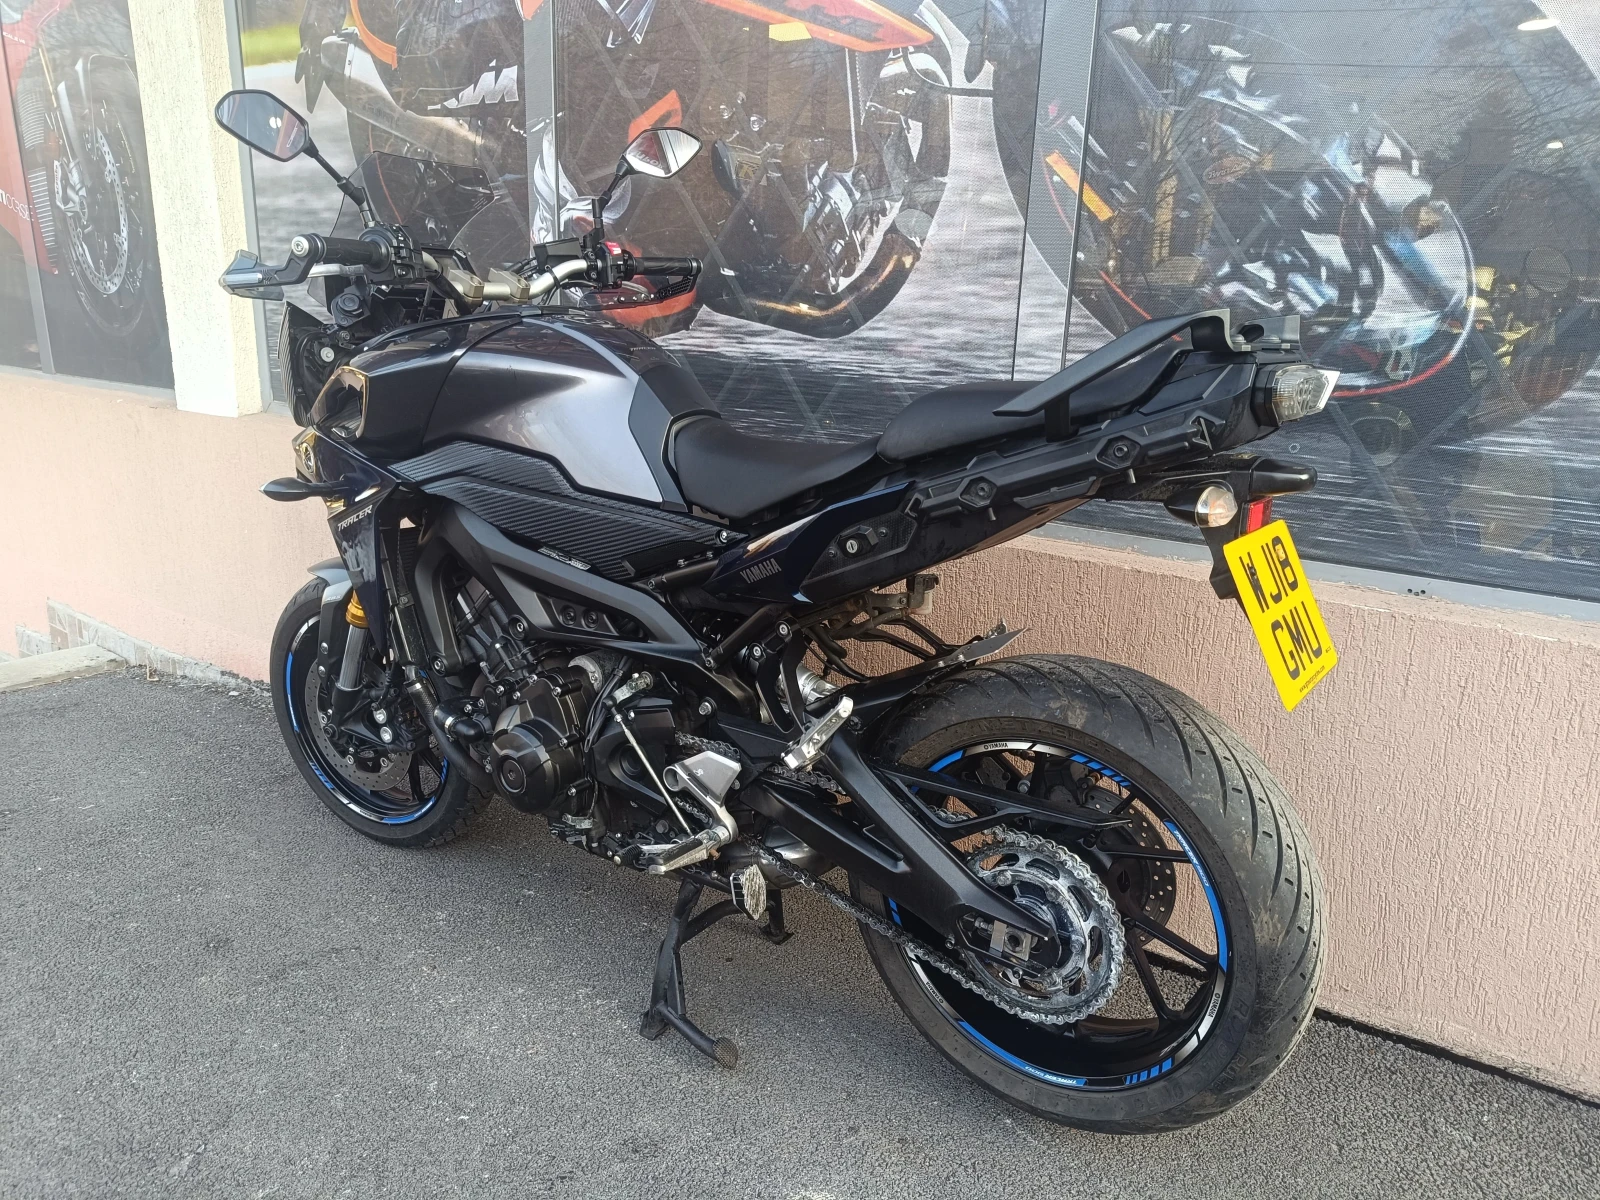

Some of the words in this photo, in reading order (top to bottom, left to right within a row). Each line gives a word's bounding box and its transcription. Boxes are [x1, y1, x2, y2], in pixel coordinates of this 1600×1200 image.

[337, 504, 373, 532] TRACER
[739, 557, 782, 584] YAMAHA
[1270, 600, 1323, 681] GMU
[987, 742, 1009, 750] YAMAHA
[1172, 829, 1199, 866] TRACER
